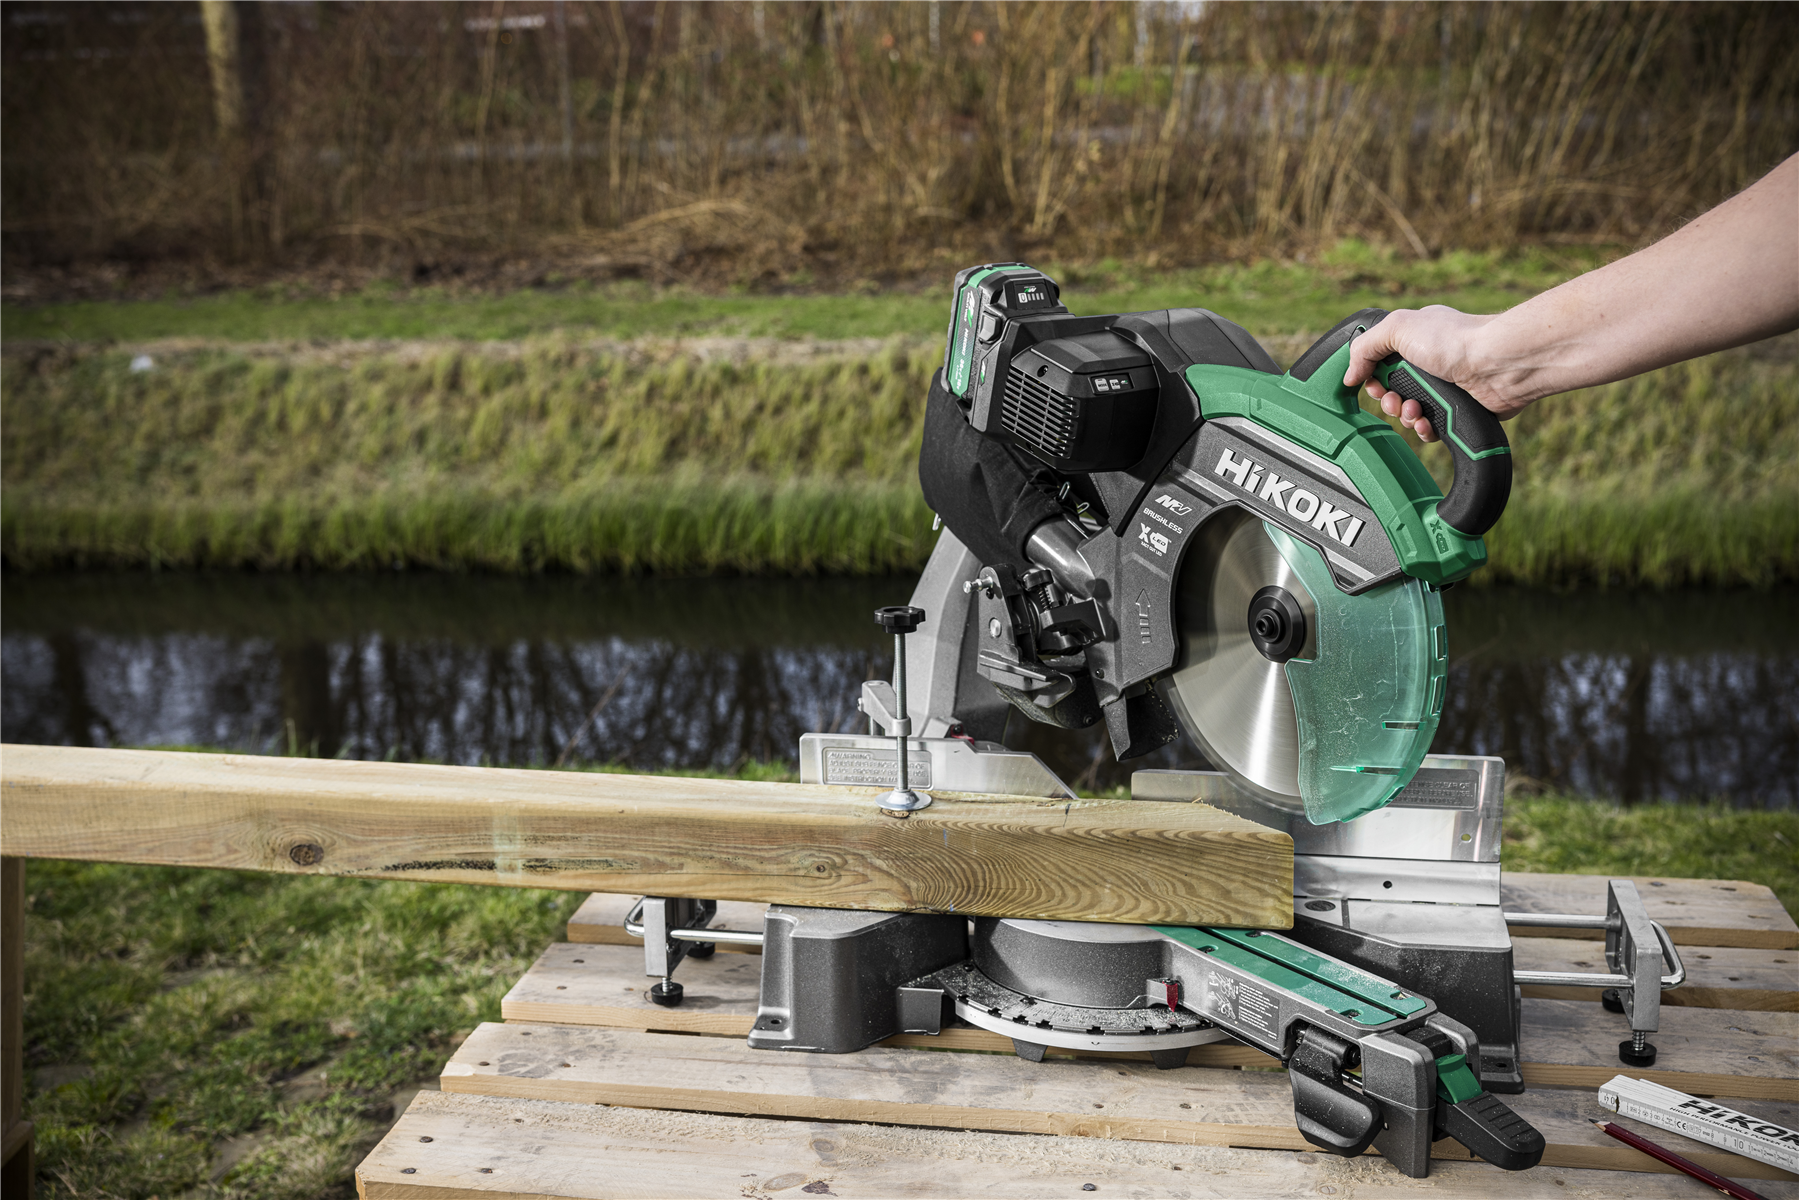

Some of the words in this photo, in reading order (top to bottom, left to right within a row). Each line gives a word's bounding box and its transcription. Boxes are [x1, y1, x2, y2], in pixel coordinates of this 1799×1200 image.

[1143, 507, 1183, 534] BRUSHLESS
[1691, 1114, 1749, 1135] PERFORMANCE
[1751, 1133, 1782, 1146] POWER
